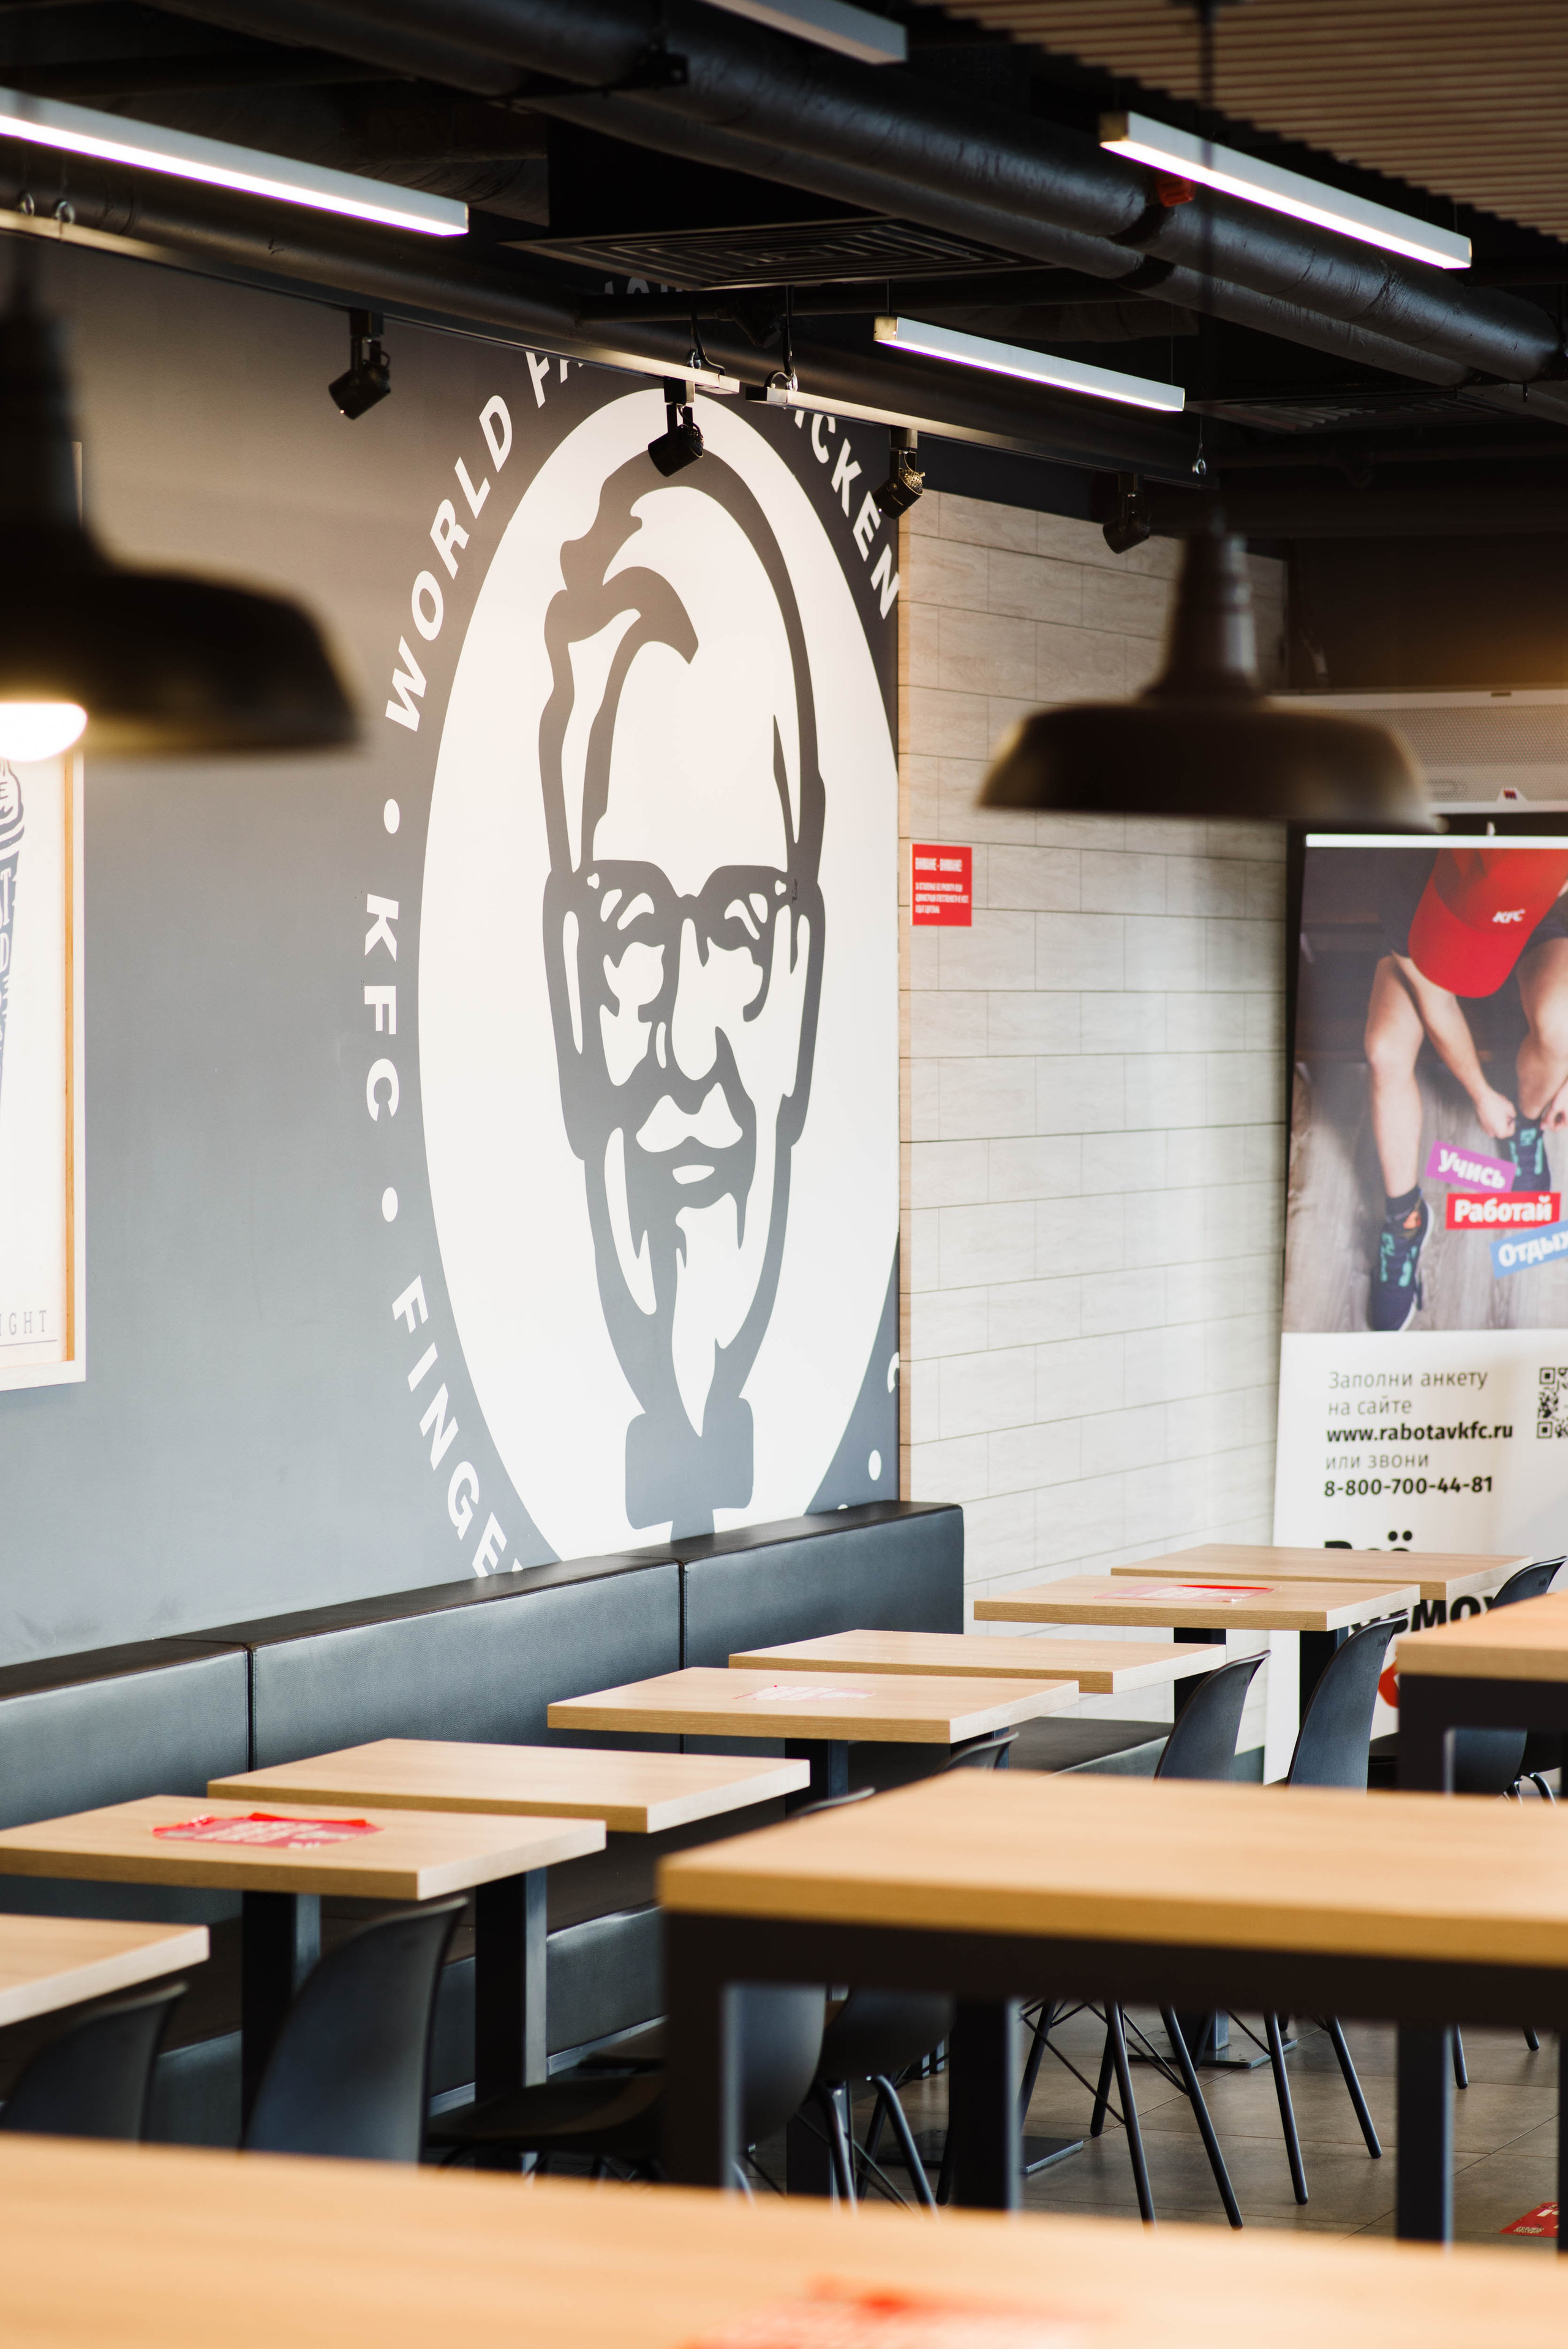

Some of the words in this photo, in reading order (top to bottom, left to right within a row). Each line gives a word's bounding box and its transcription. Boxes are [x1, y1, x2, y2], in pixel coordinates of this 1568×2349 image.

[385, 394, 513, 733] WORLD
[1492, 908, 1526, 924] KFC
[364, 893, 399, 1122] KFC
[1438, 1148, 1506, 1190] Учись
[1454, 1194, 1553, 1223] Работай
[1329, 1371, 1413, 1389] Заполни
[1420, 1371, 1488, 1390] анкету
[1328, 1401, 1350, 1416] на
[1357, 1395, 1412, 1415] сайте
[391, 1274, 524, 1578] FINGE
[1327, 1421, 1513, 1442] www.rabotavkfc.ru
[1326, 1455, 1360, 1470] или
[1367, 1454, 1429, 1469] звони
[1324, 1476, 1493, 1497] 8-800-700-44-81
